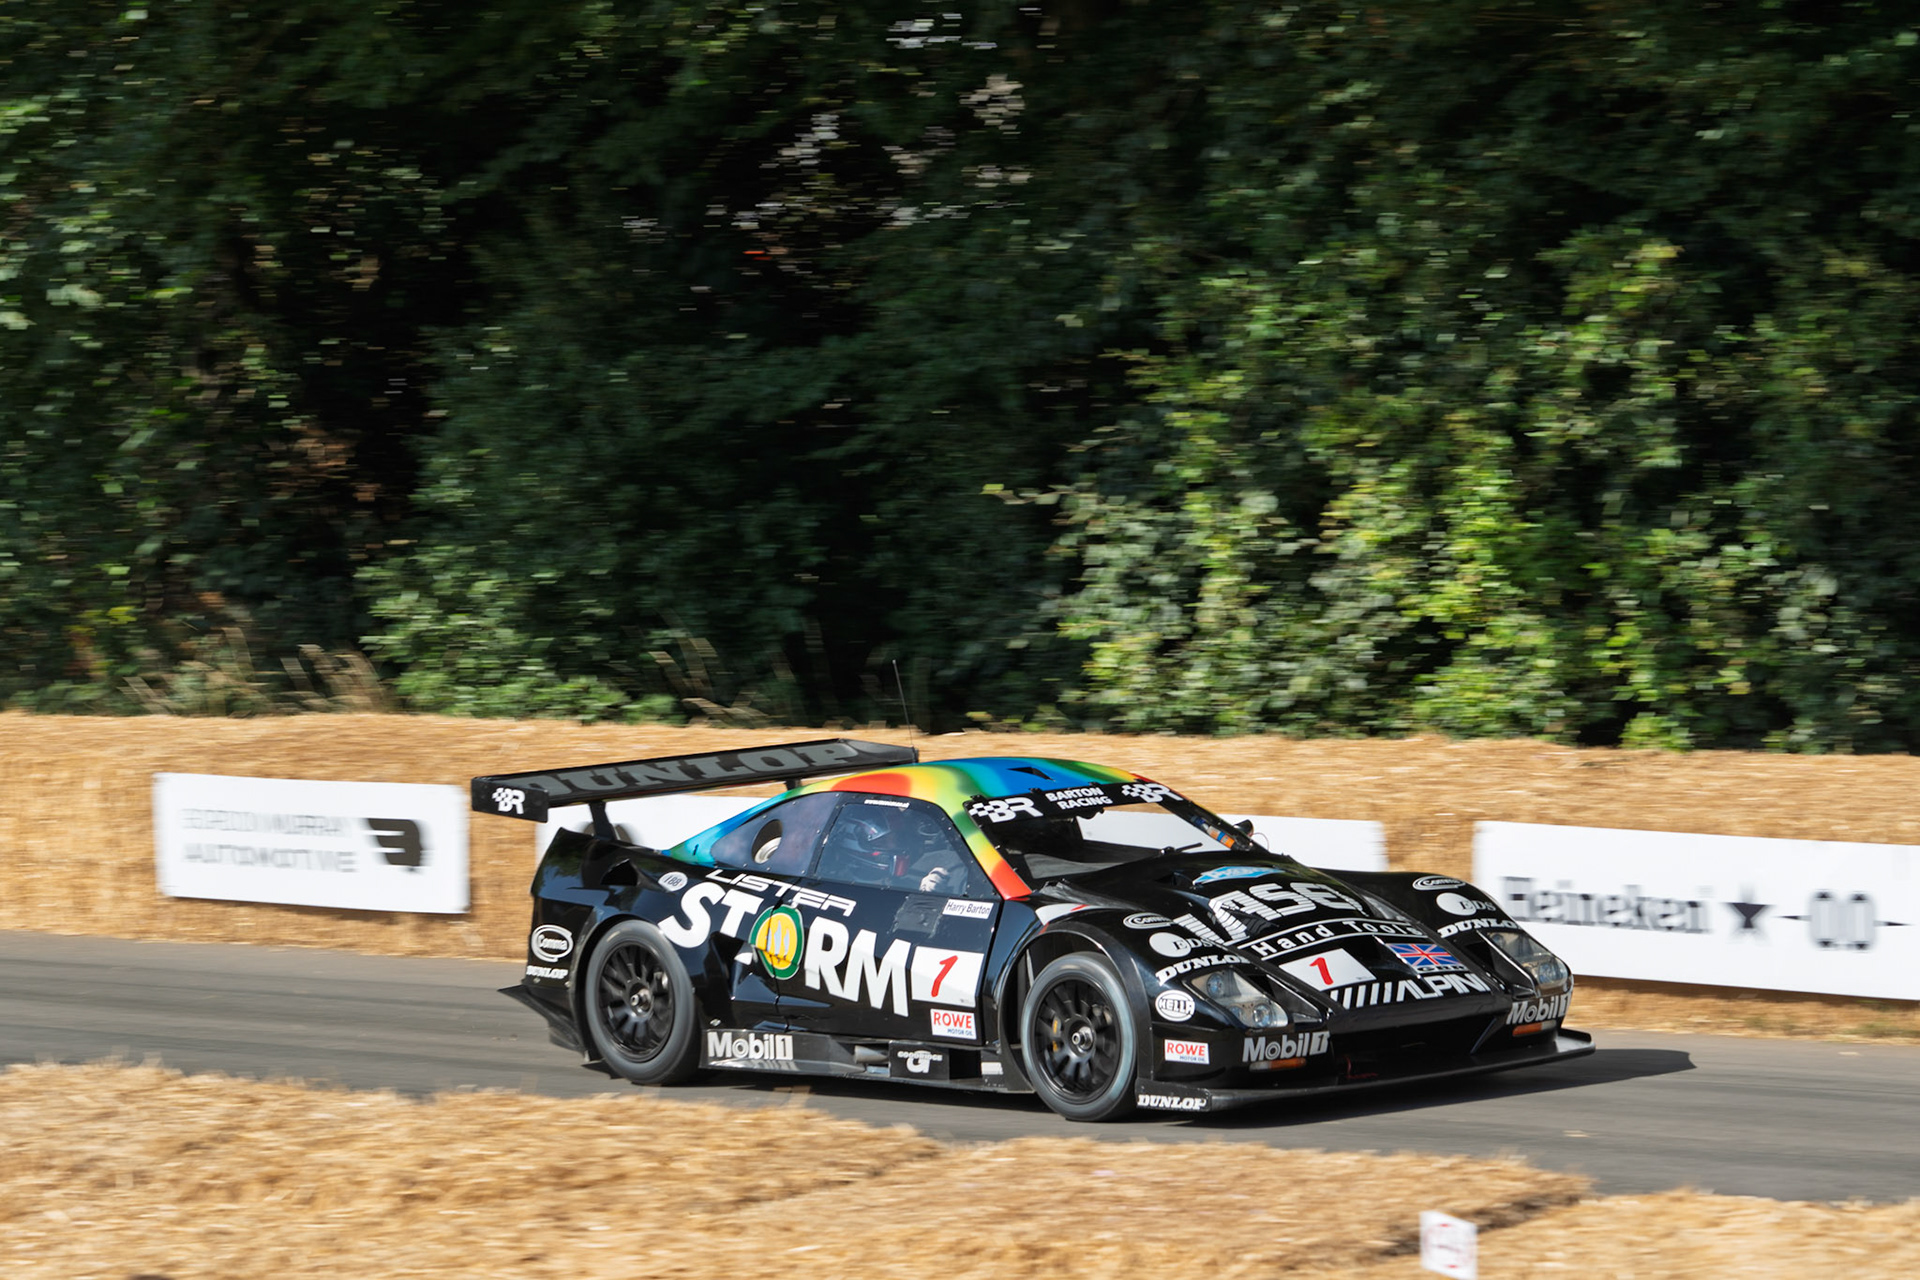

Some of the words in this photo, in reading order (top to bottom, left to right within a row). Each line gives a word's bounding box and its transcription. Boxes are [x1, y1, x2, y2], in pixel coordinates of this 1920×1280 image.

[1045, 787, 1104, 802] BARTON
[1057, 796, 1114, 810] RACING
[705, 869, 857, 917] LISTER
[1499, 875, 1716, 935] Heineken
[946, 901, 966, 914] Harry
[967, 903, 990, 915] Barton
[1173, 882, 1370, 949] LASE
[1251, 924, 1335, 957] Hand
[1342, 920, 1423, 935] Tools
[1437, 918, 1522, 938] DUNLO
[538, 934, 568, 951] Comma
[526, 965, 569, 979] DUNLOP
[931, 955, 958, 997] 1
[1309, 957, 1334, 985] 1
[1396, 973, 1491, 1002] ALPIN
[1159, 998, 1195, 1015] HELLA
[1506, 995, 1559, 1025] Mobil
[933, 1011, 972, 1029] ROWE
[707, 1031, 774, 1060] Mobil
[775, 1034, 793, 1060] 1
[1167, 1042, 1205, 1056] ROWE
[1242, 1032, 1309, 1063] Mobil
[1309, 1031, 1330, 1056] 1
[1137, 1094, 1206, 1110] DUNLOP
